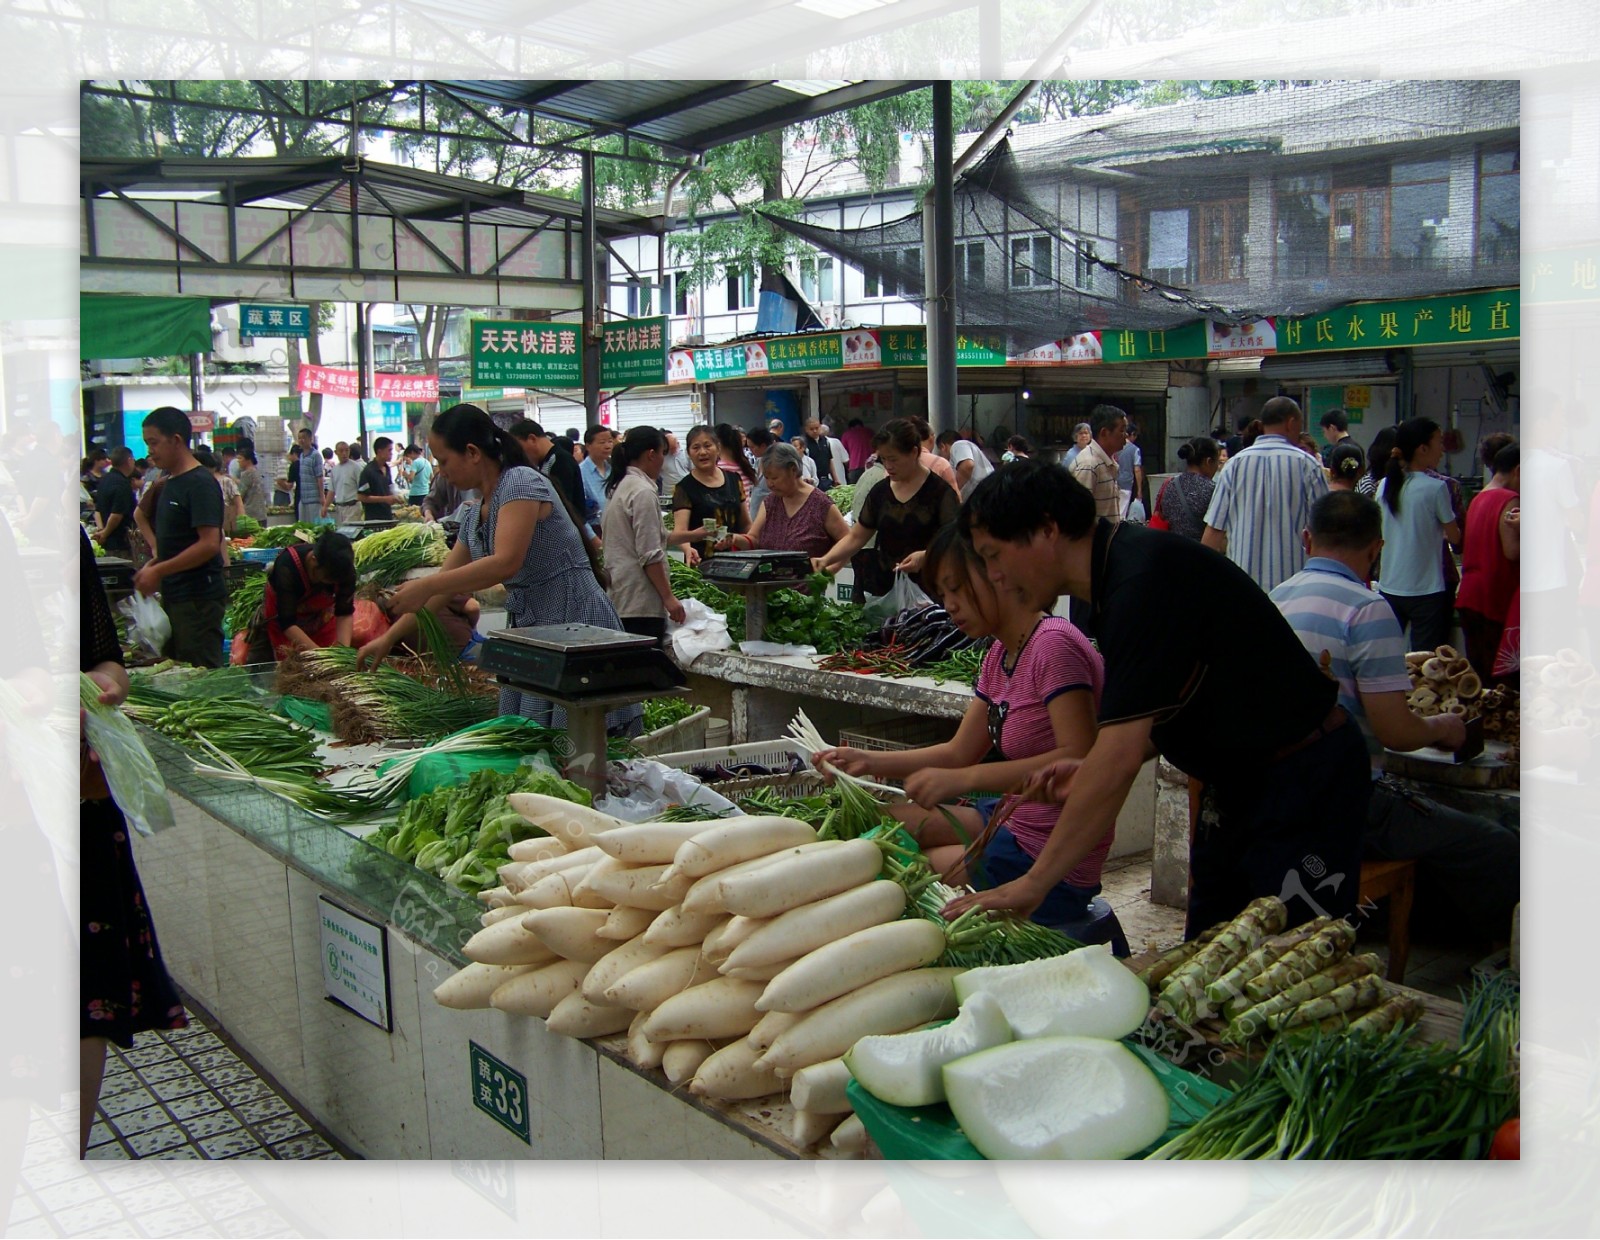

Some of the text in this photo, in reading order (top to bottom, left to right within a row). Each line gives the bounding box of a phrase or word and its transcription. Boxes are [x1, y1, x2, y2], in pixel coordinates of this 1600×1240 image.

[247, 309, 304, 326] 蔬菜区
[1285, 301, 1511, 345] 付氏水果产地直
[481, 329, 577, 355] 天天快洁菜
[604, 324, 662, 353] 天天快洁菜
[1119, 329, 1166, 356] 出口
[478, 1058, 523, 1125] 蔬菜 33
